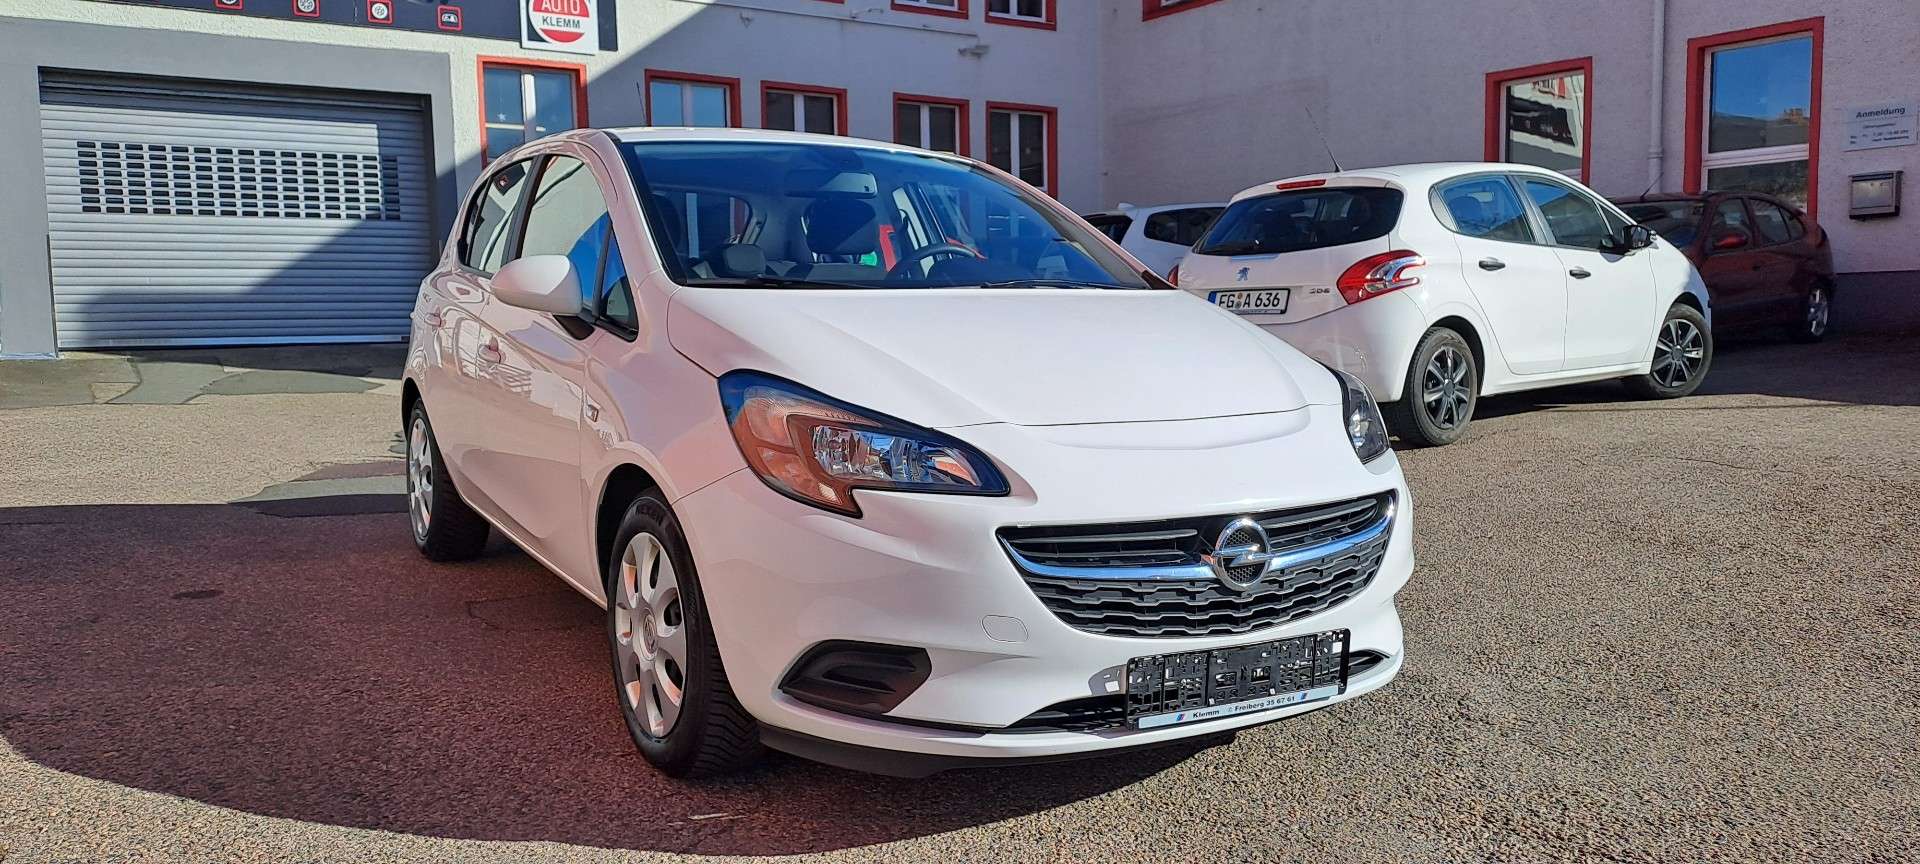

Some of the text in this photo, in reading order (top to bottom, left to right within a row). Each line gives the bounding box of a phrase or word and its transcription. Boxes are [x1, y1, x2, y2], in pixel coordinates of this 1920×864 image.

[541, 0, 580, 14] AUTO
[542, 16, 581, 29] KLEMM
[1856, 107, 1905, 118] Anmeldung
[1218, 292, 1280, 308] FG A 636
[1193, 709, 1220, 719] Klemm
[1234, 702, 1264, 711] Freiberg
